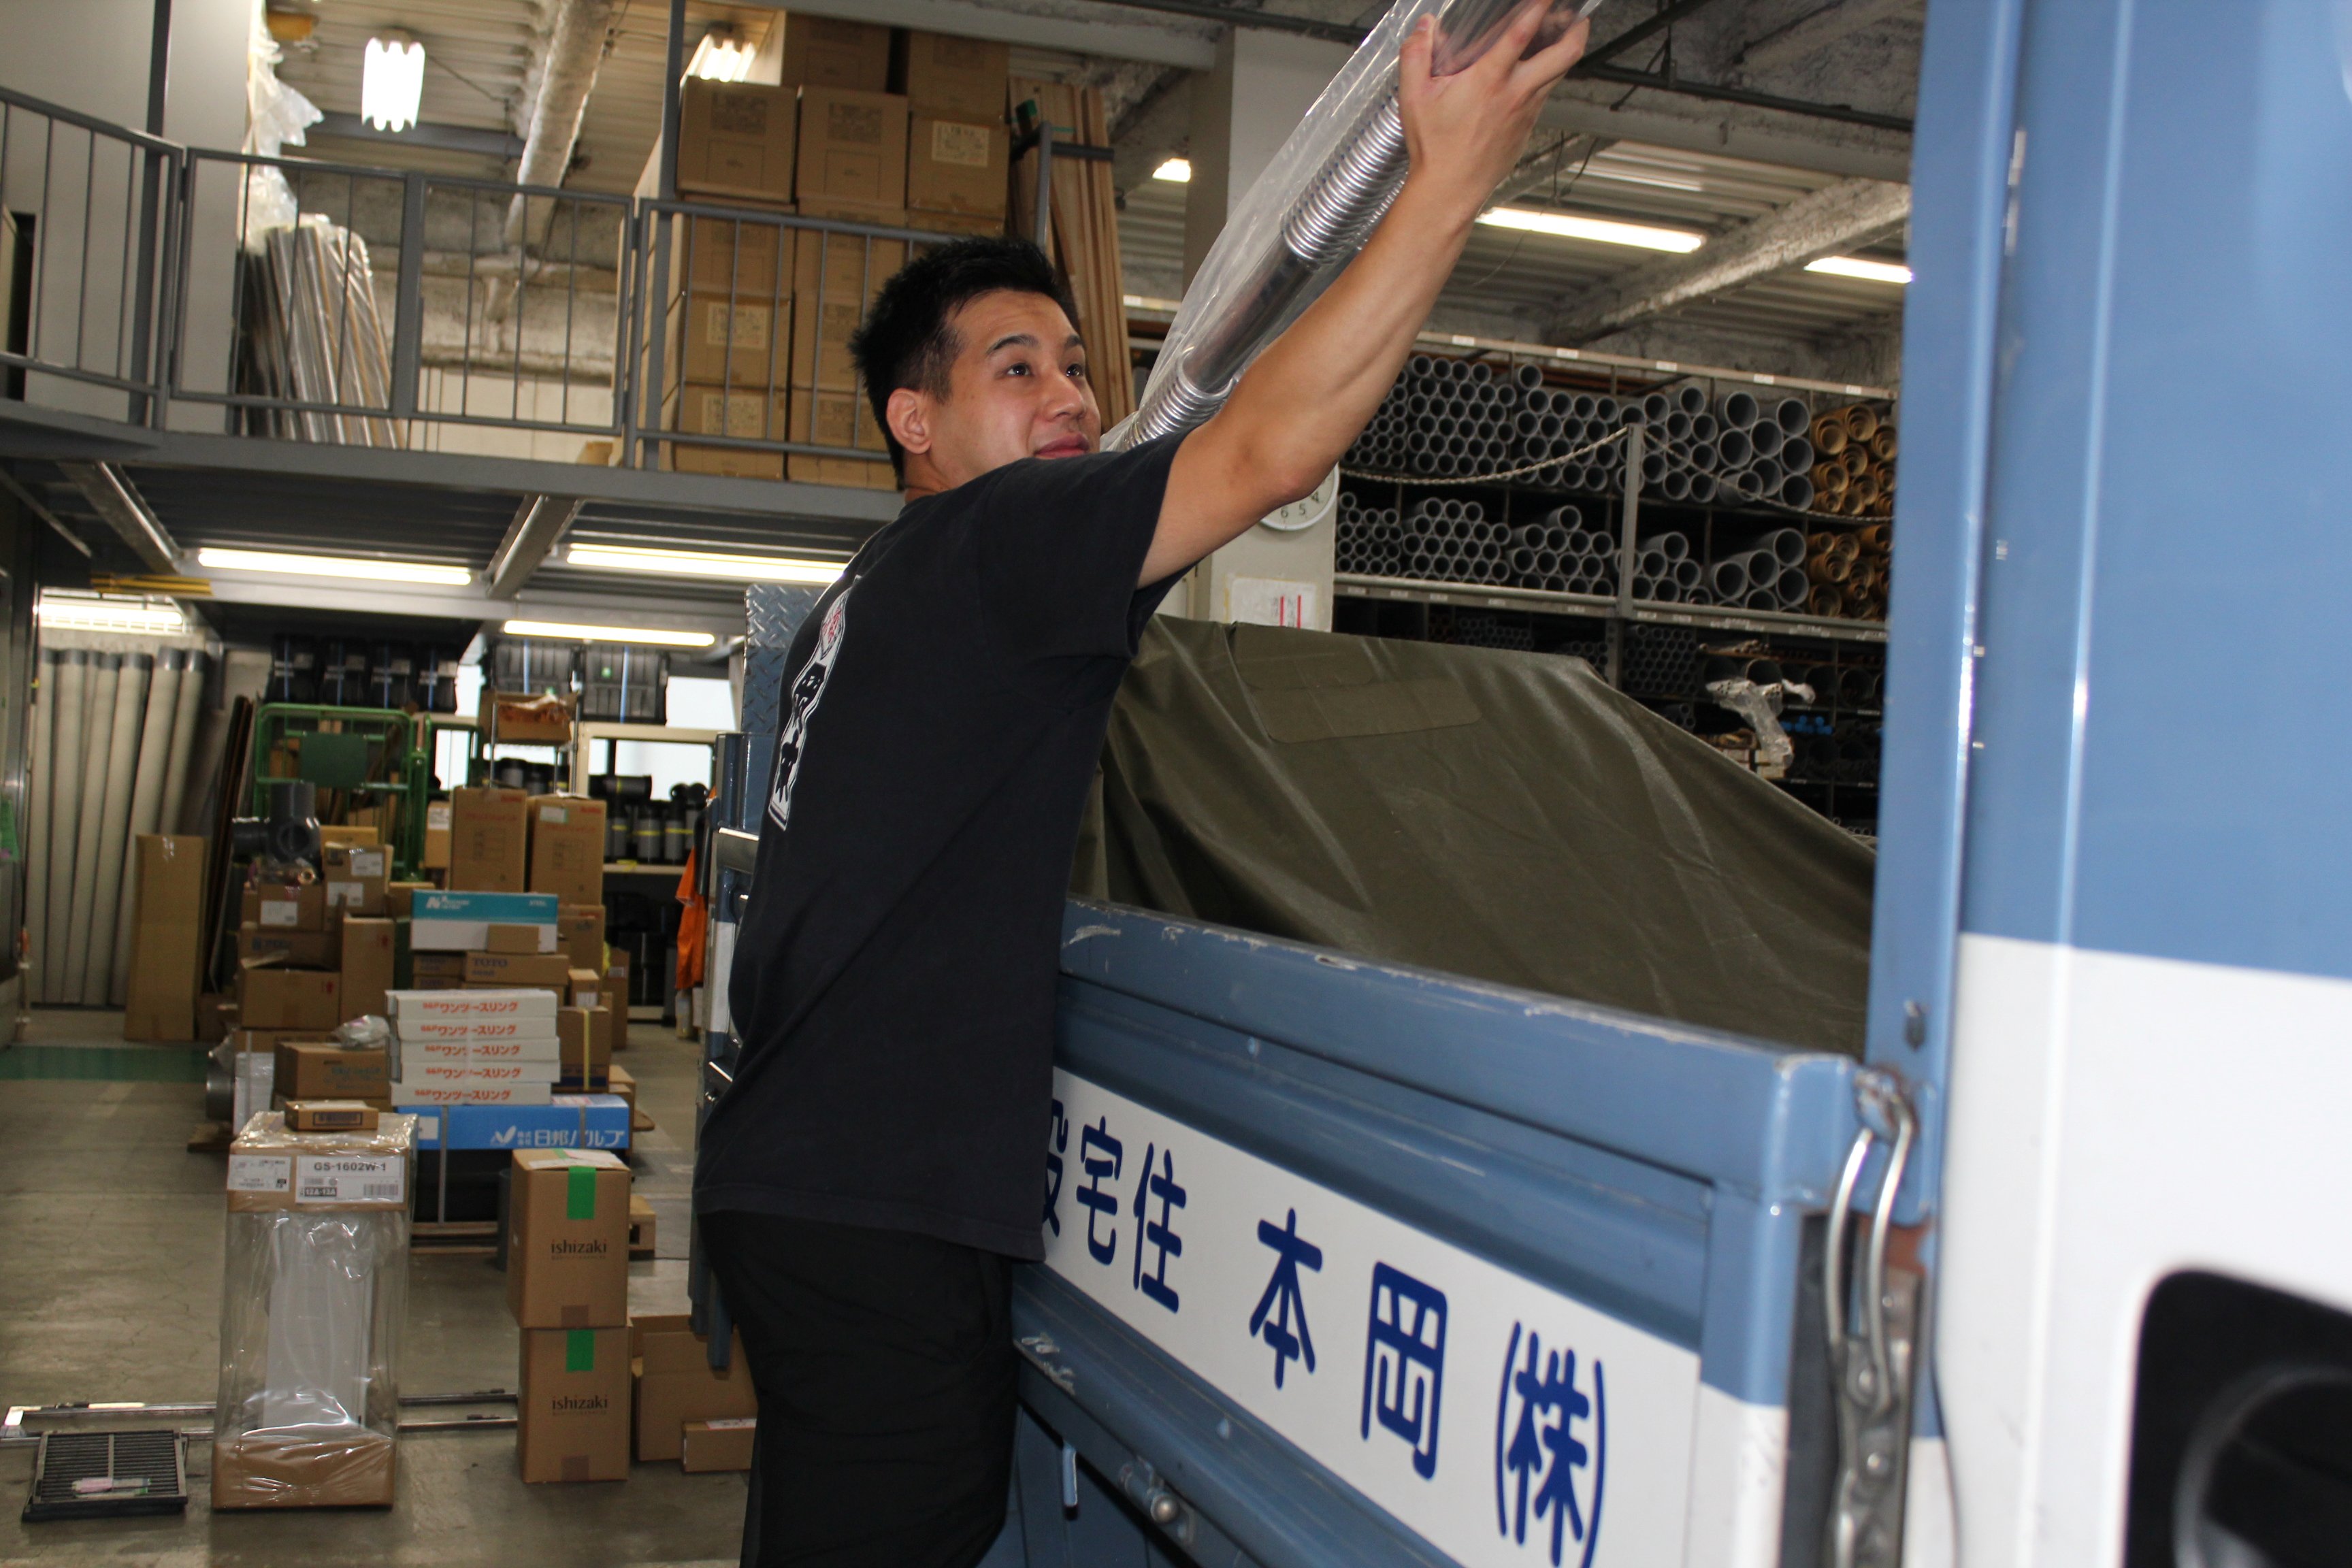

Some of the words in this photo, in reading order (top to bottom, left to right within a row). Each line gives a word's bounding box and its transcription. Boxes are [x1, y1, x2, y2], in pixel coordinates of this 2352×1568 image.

[1299, 504, 1305, 515] 5
[551, 1239, 607, 1254] ishizaki
[552, 1394, 608, 1409] ishizaki
